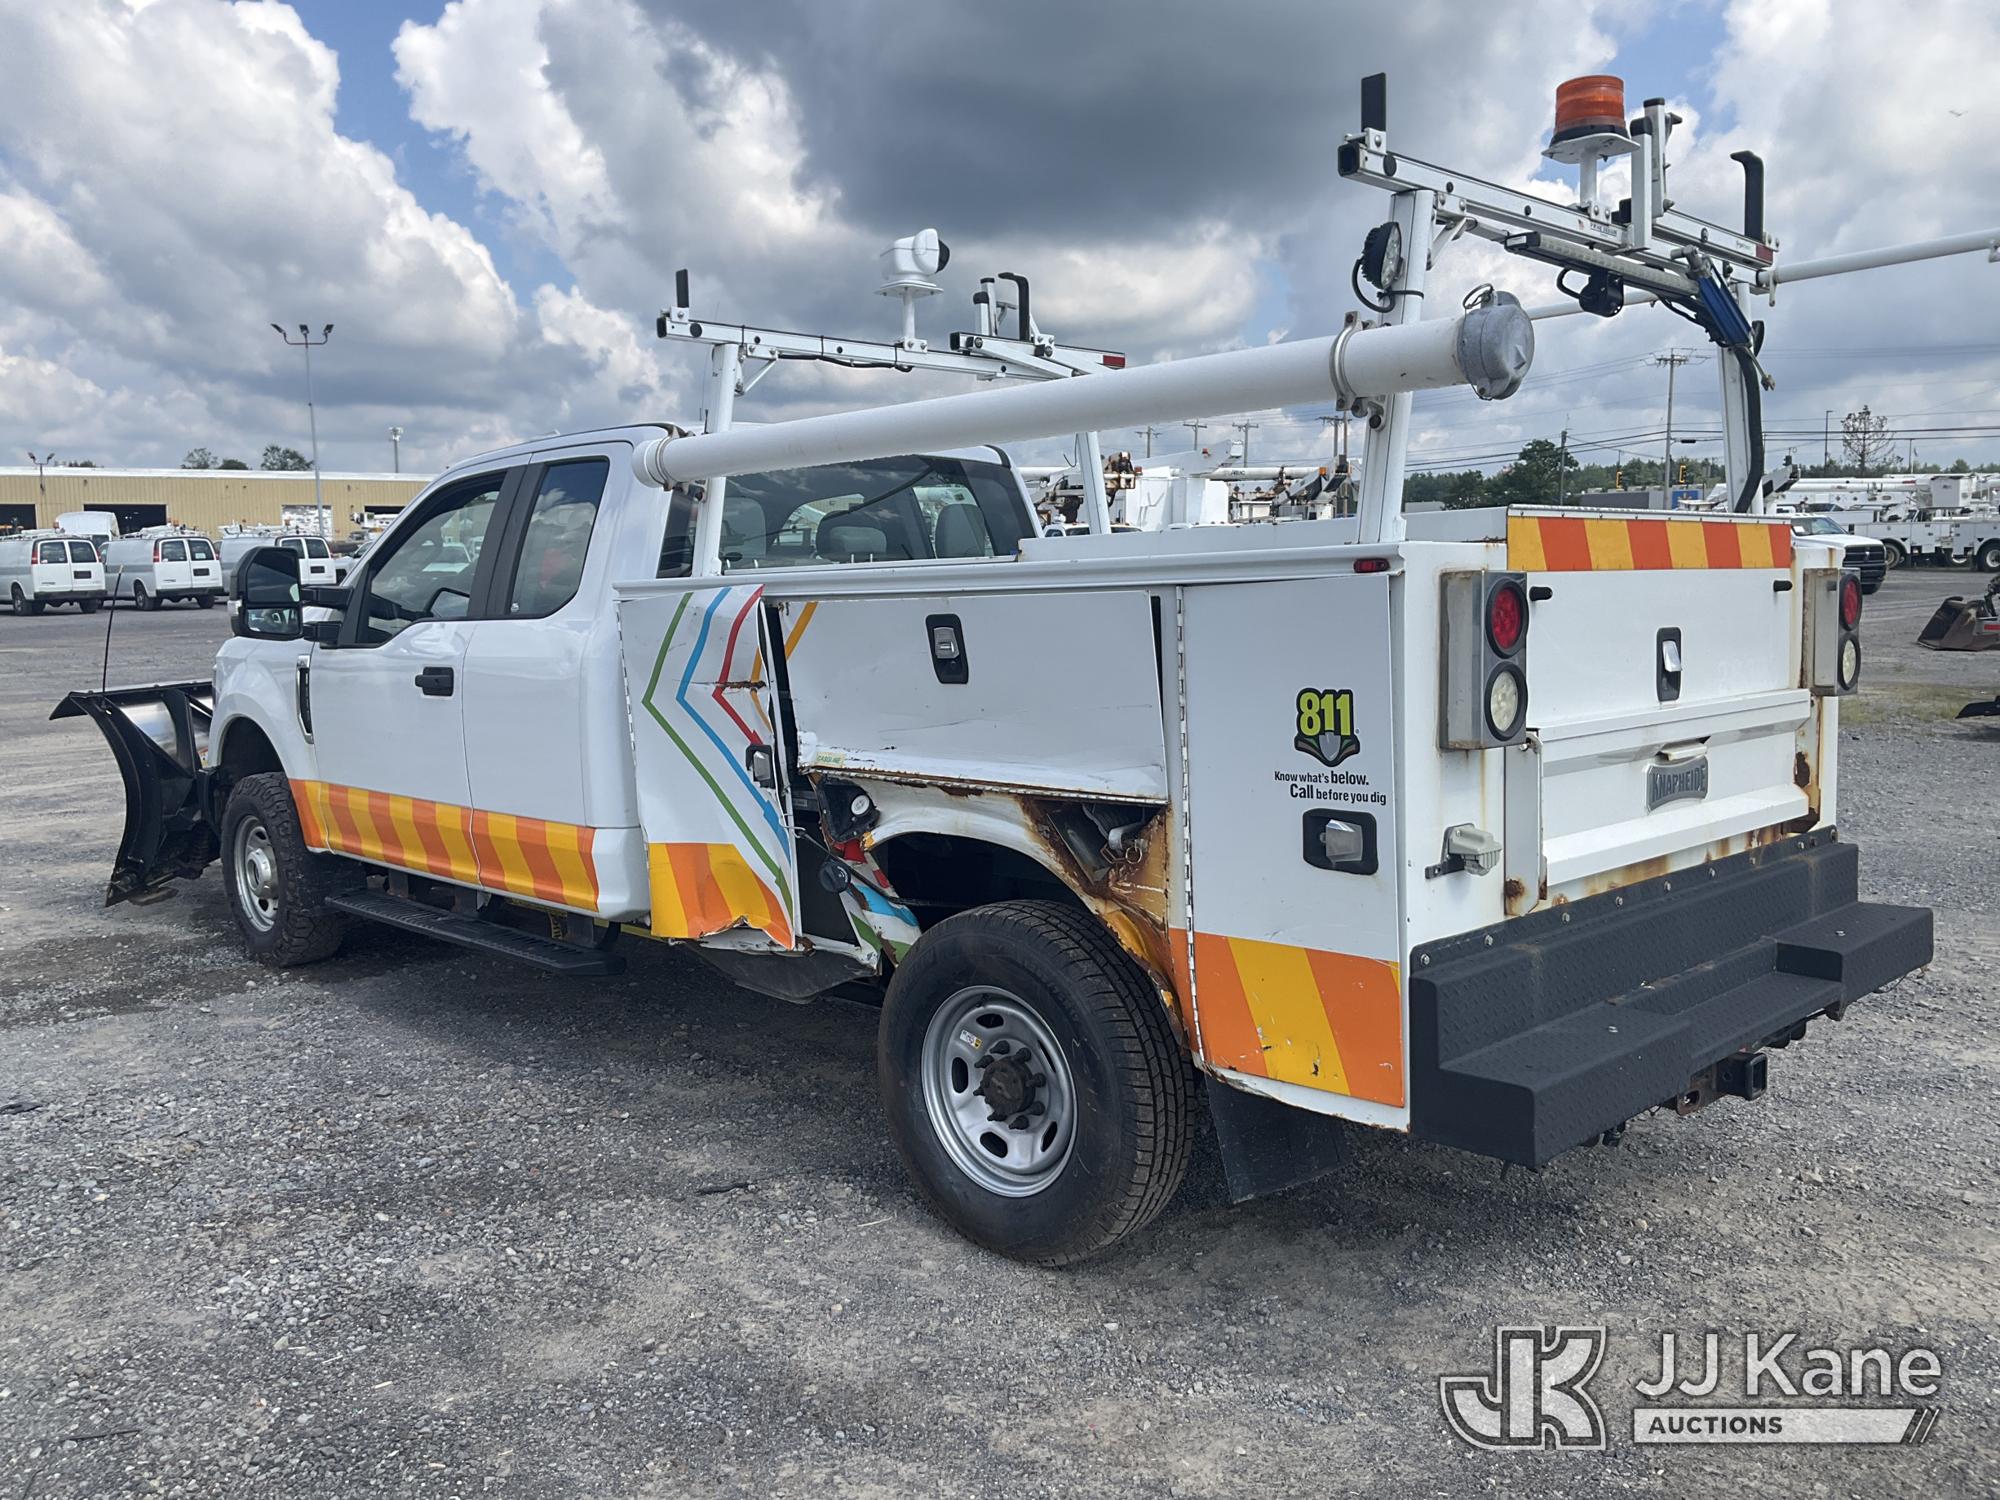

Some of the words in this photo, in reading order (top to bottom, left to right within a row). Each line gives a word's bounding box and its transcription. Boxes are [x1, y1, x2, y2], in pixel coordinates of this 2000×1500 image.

[1300, 691, 1351, 736] 811
[1274, 771, 1298, 782] Know
[1299, 772, 1330, 784] what's
[1330, 770, 1369, 786] below.
[1652, 765, 1706, 803] KNAPHEIDE
[1290, 783, 1314, 799] Call
[1316, 788, 1349, 801] before
[1350, 792, 1369, 804] you
[1370, 791, 1387, 806] dig
